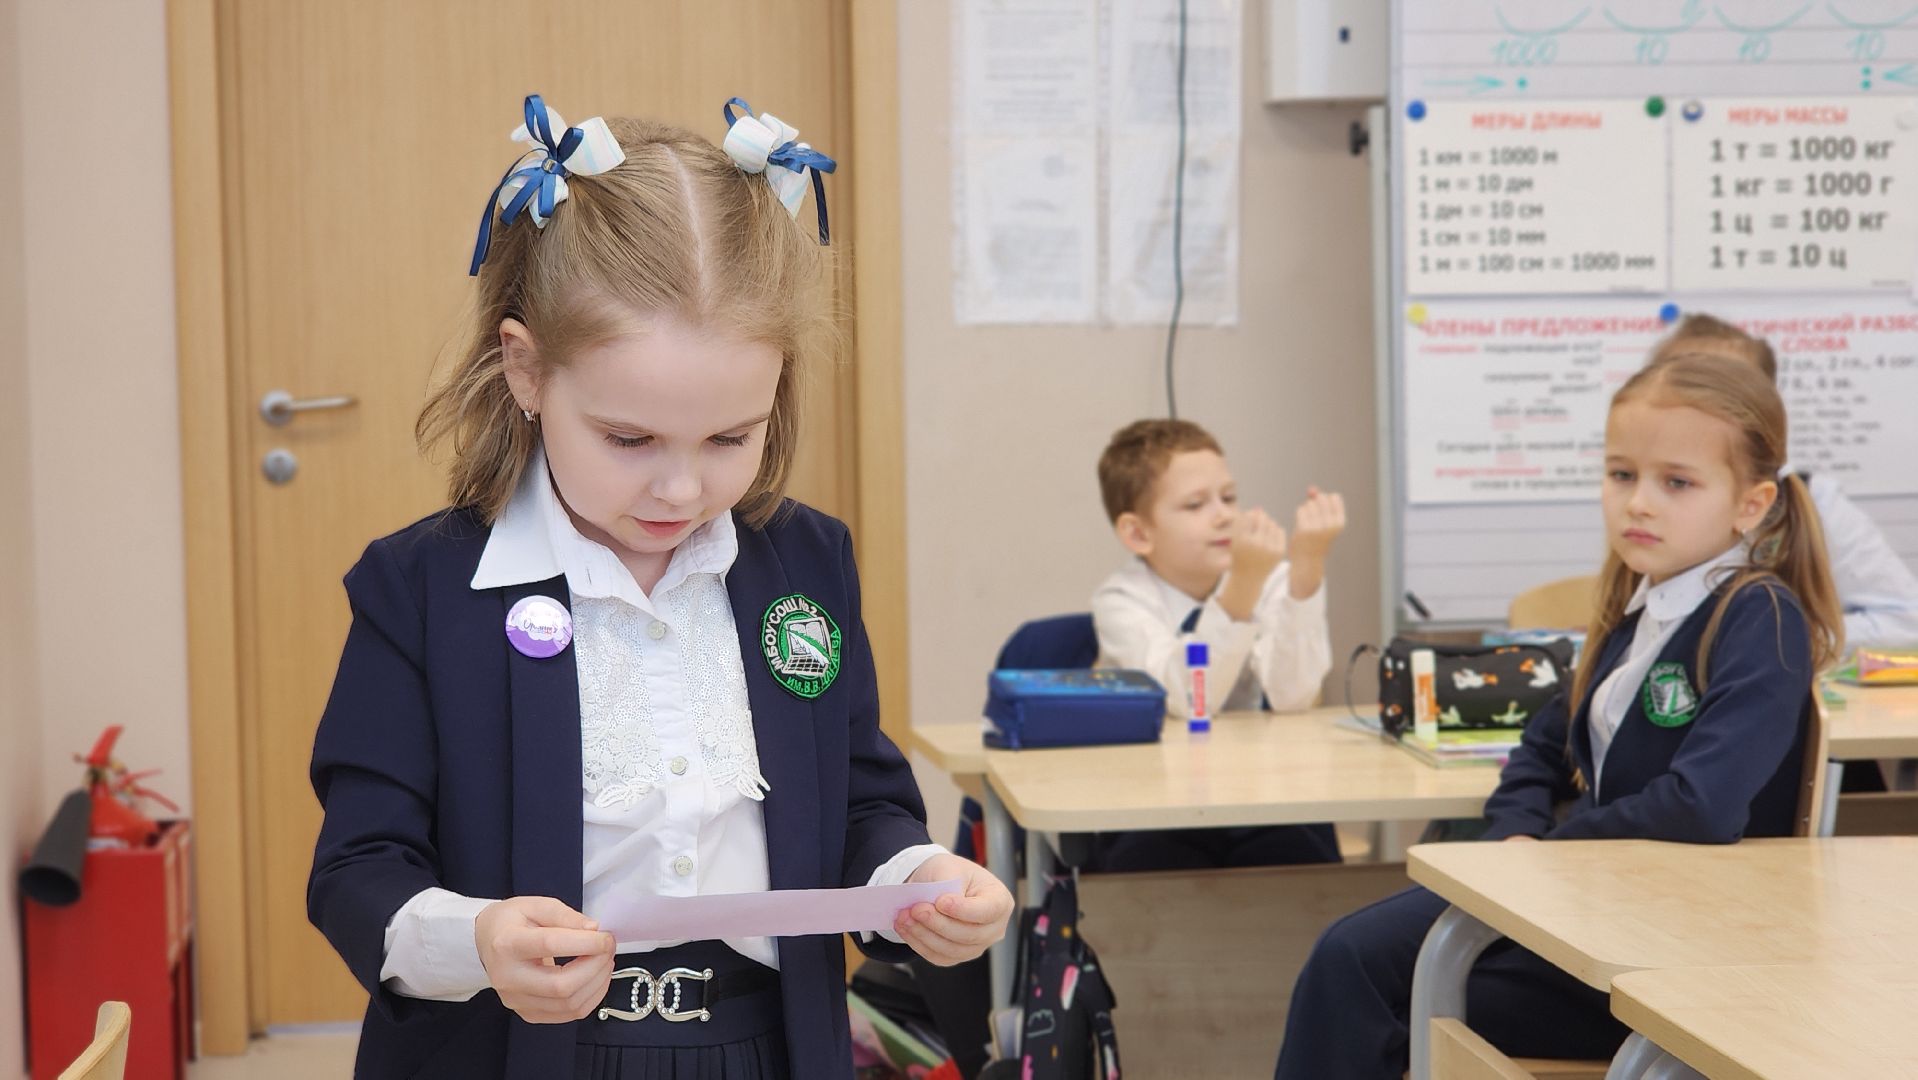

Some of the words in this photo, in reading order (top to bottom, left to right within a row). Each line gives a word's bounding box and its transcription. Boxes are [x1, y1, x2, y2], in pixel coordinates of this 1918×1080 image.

[1492, 34, 1558, 66] 1000
[1635, 33, 1668, 65] 10
[1738, 33, 1771, 64] 10
[1847, 31, 1886, 62] 10
[1472, 113, 1525, 129] МЕРЫ
[1531, 113, 1602, 131] ДЛИНЫ
[1728, 107, 1779, 123] МЕРЫ
[1785, 107, 1848, 123] МАССЫ
[1419, 149, 1429, 166] 1
[1435, 152, 1462, 164] км
[1490, 148, 1539, 165] 1000
[1711, 138, 1724, 162] 1
[1734, 142, 1748, 161] т
[1790, 136, 1857, 161] 1000
[1864, 141, 1894, 159] кг
[1419, 175, 1429, 192] 1
[1477, 174, 1501, 193] 10
[1505, 178, 1534, 192] дм
[1711, 174, 1724, 198] 1
[1734, 178, 1765, 196] кг
[1805, 172, 1872, 197] 1000
[1880, 176, 1894, 195] г
[1419, 202, 1429, 220] 1
[1434, 206, 1463, 220] дм
[1490, 201, 1514, 219] 10
[1518, 205, 1544, 217] см
[1711, 210, 1724, 234] 1
[1734, 214, 1753, 236] ц
[1801, 207, 1851, 233] 100
[1858, 212, 1888, 231] кг
[1419, 228, 1429, 247] 1
[1435, 232, 1460, 244] см
[1488, 228, 1512, 246] 10
[1419, 255, 1429, 273] 1
[1478, 254, 1514, 272] 100
[1518, 258, 1544, 271] см
[1571, 252, 1620, 272] 1000
[1711, 246, 1724, 269] 1
[1734, 249, 1748, 268] т
[1788, 244, 1822, 268] 10
[1829, 249, 1848, 270] ц
[1781, 335, 1849, 352] СЛОВА
